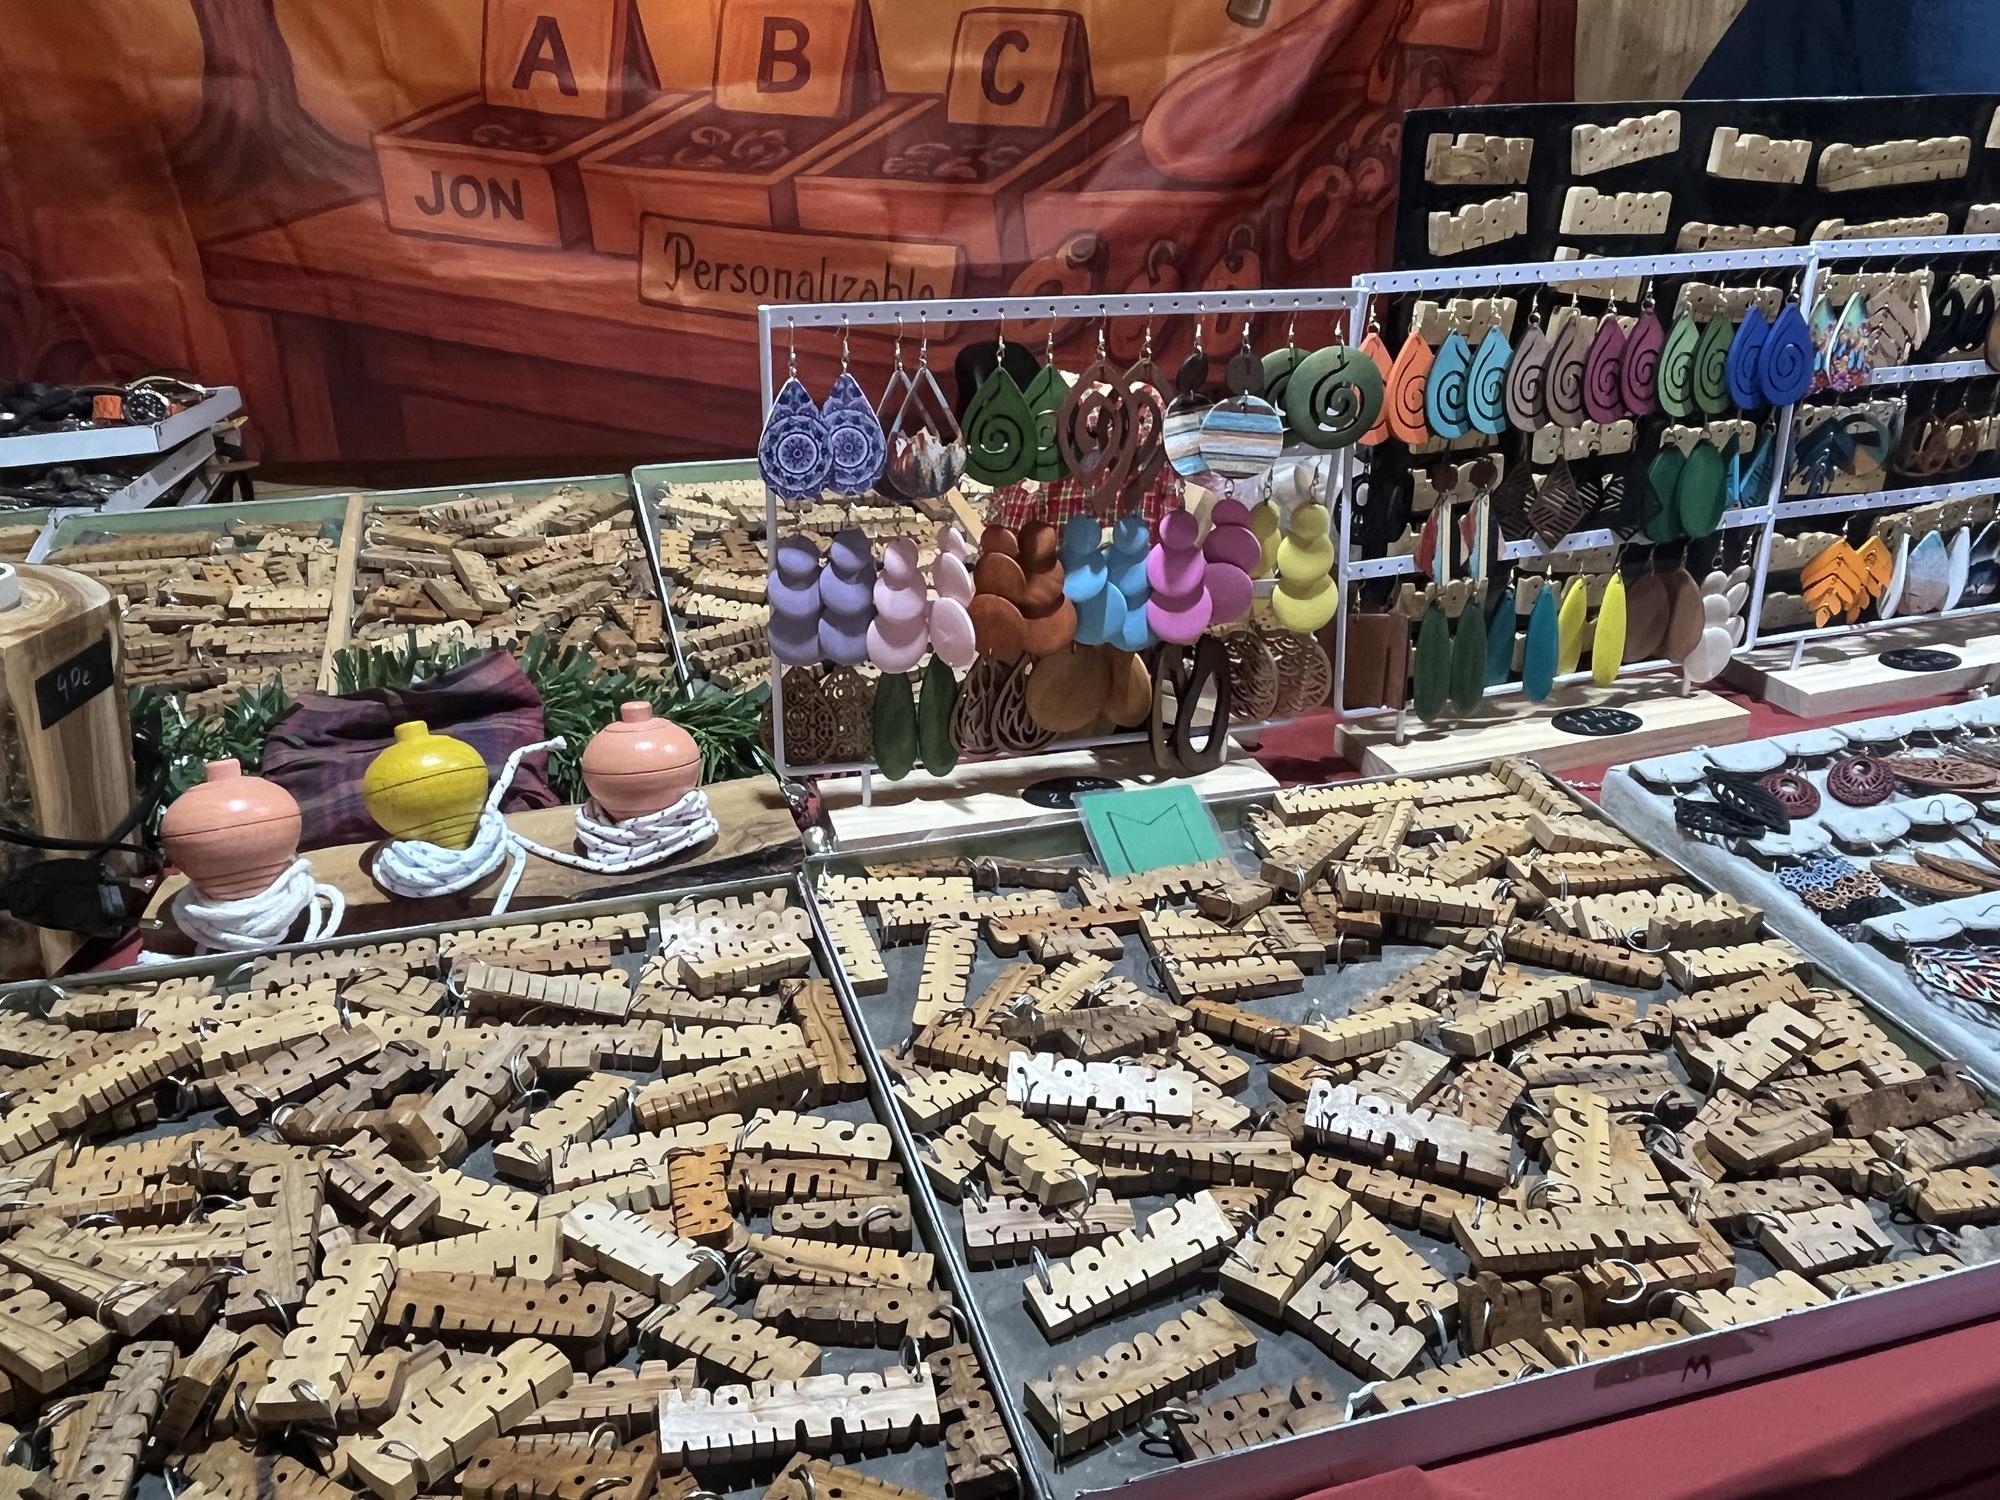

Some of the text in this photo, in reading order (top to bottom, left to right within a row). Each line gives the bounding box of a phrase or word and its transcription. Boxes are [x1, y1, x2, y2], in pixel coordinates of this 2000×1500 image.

[512, 15, 579, 97] A
[757, 16, 812, 93] B
[980, 30, 1030, 106] C
[414, 170, 525, 222] JON
[1106, 803, 1203, 874] M
[1682, 1354, 1713, 1383] M
